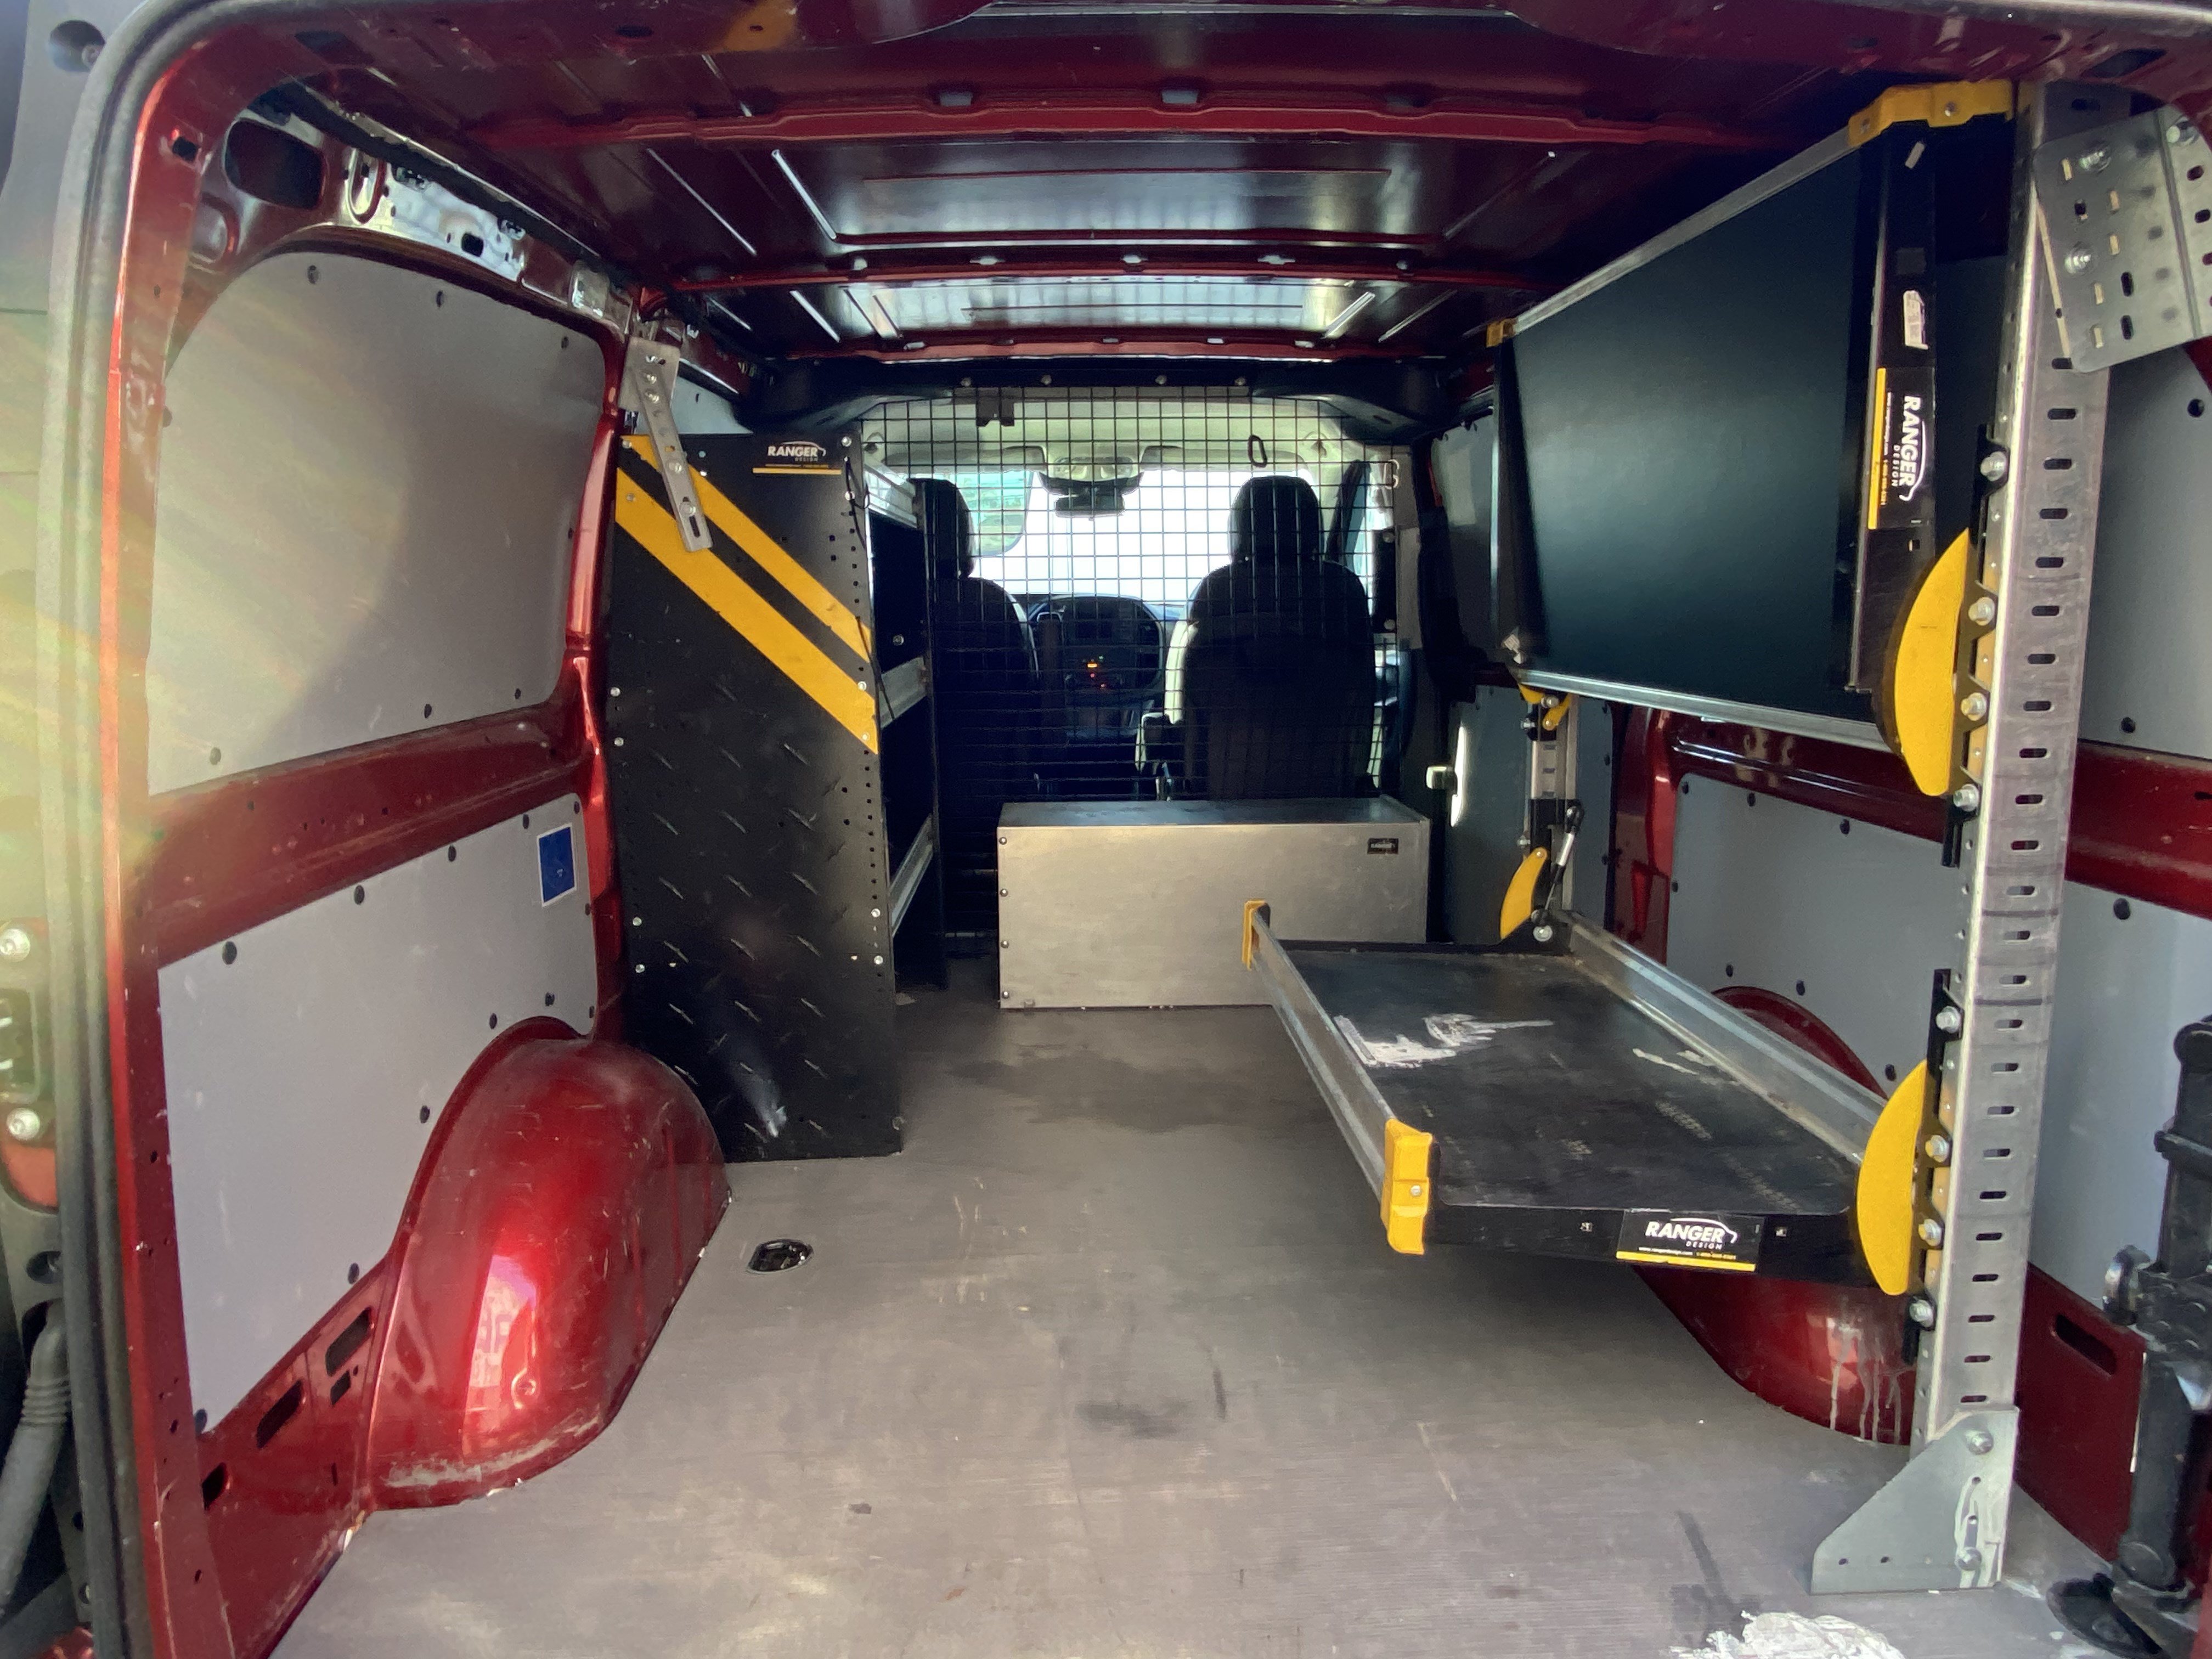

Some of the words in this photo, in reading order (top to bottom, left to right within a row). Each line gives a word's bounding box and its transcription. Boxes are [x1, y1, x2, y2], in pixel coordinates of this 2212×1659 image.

[768, 445, 818, 456] RANGER
[1898, 395, 1921, 487] RANGER
[1892, 444, 1901, 487] DESIGN
[1645, 1221, 1725, 1243] RANGER
[1685, 1241, 1723, 1250] DESIGN
